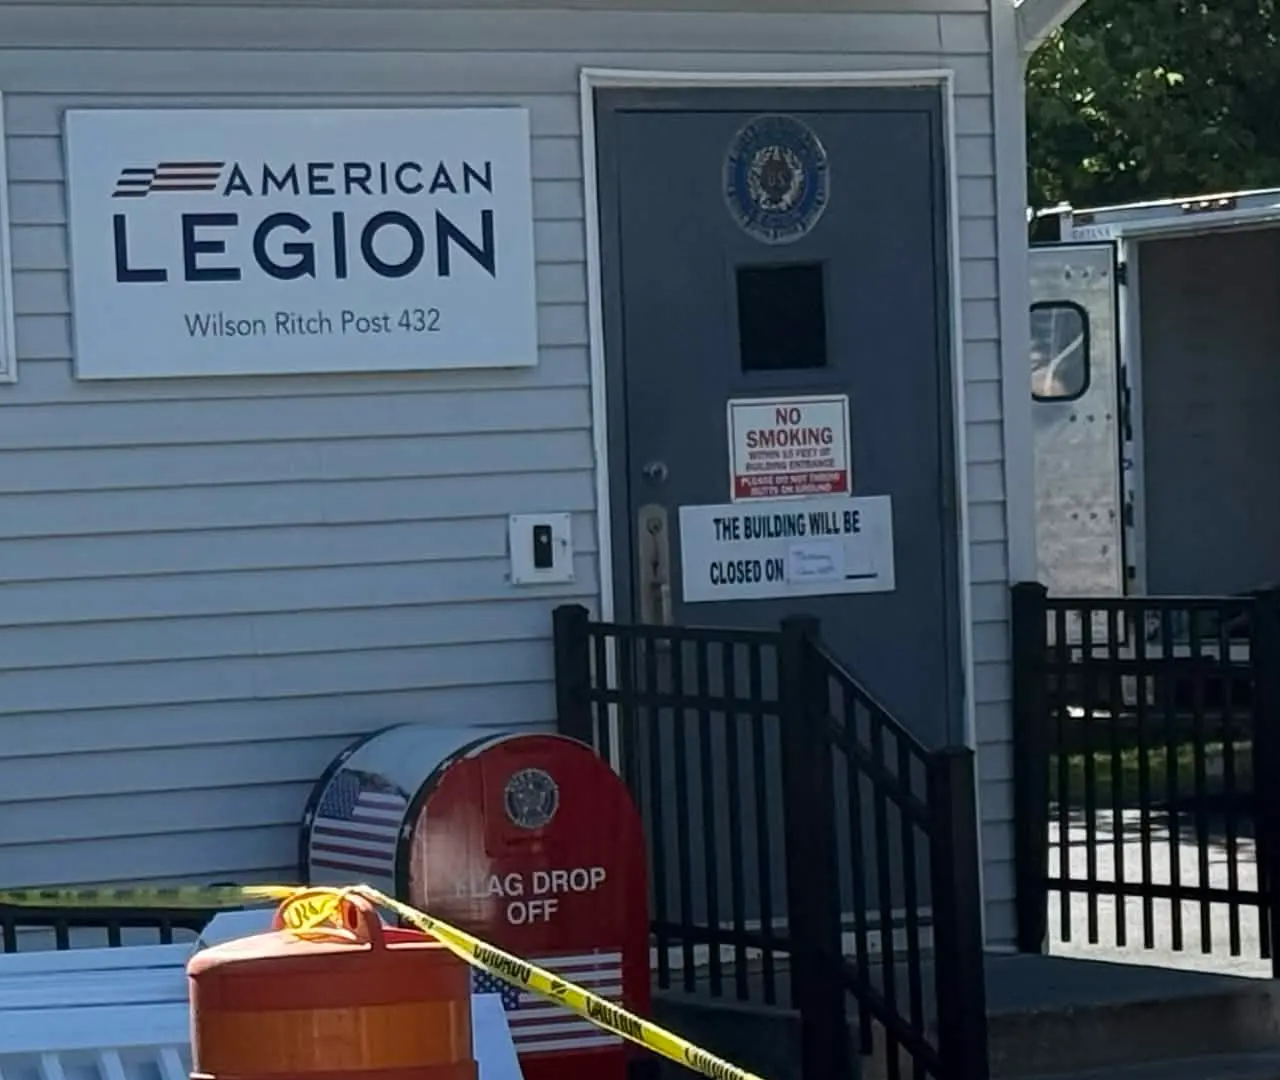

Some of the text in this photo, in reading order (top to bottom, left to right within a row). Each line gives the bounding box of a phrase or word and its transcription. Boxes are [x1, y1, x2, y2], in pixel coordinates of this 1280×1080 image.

[222, 161, 493, 196] AMERICAN
[113, 208, 496, 283] LEGION
[184, 308, 441, 338] Wilson Ritch Post 432
[775, 407, 801, 426] NO
[746, 427, 833, 449] SMOKING
[713, 510, 861, 541] THE BUILDING WILL BE
[710, 559, 762, 585] CLOSED
[765, 558, 785, 582] ON
[532, 867, 606, 895] DROP
[507, 899, 559, 925] OFF
